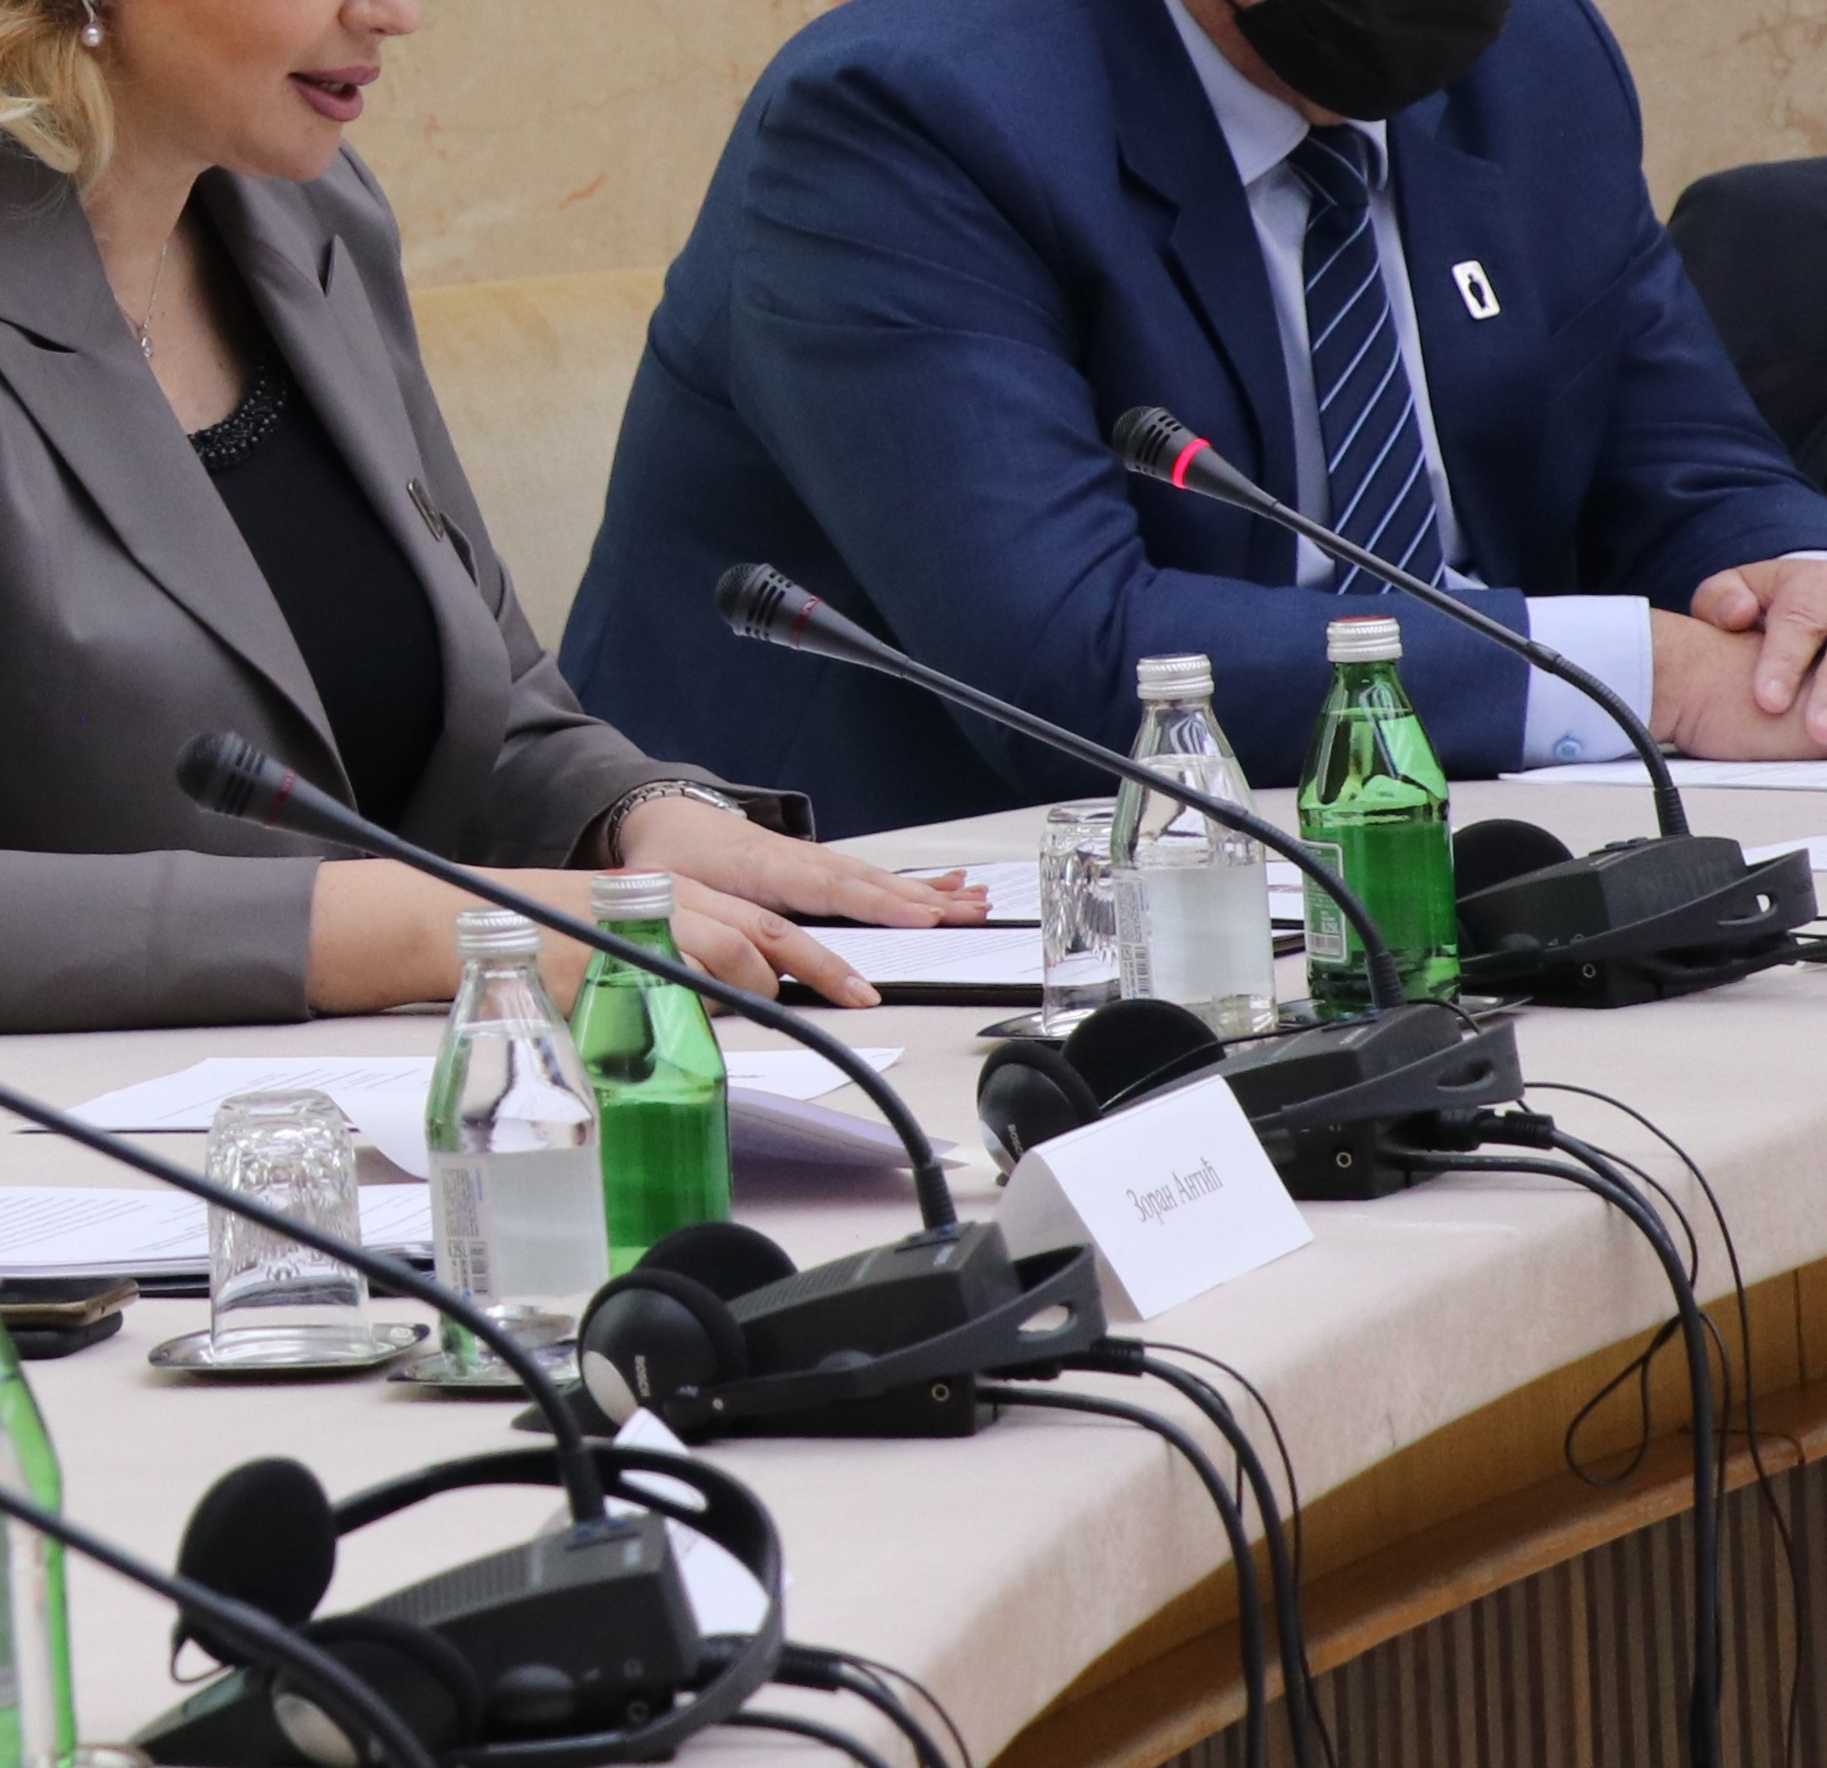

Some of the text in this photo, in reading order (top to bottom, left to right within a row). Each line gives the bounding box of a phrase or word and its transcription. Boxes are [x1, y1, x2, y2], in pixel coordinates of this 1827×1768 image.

[1007, 1124, 1024, 1156] BOSC
[1126, 1156, 1224, 1225] Зоран Антић
